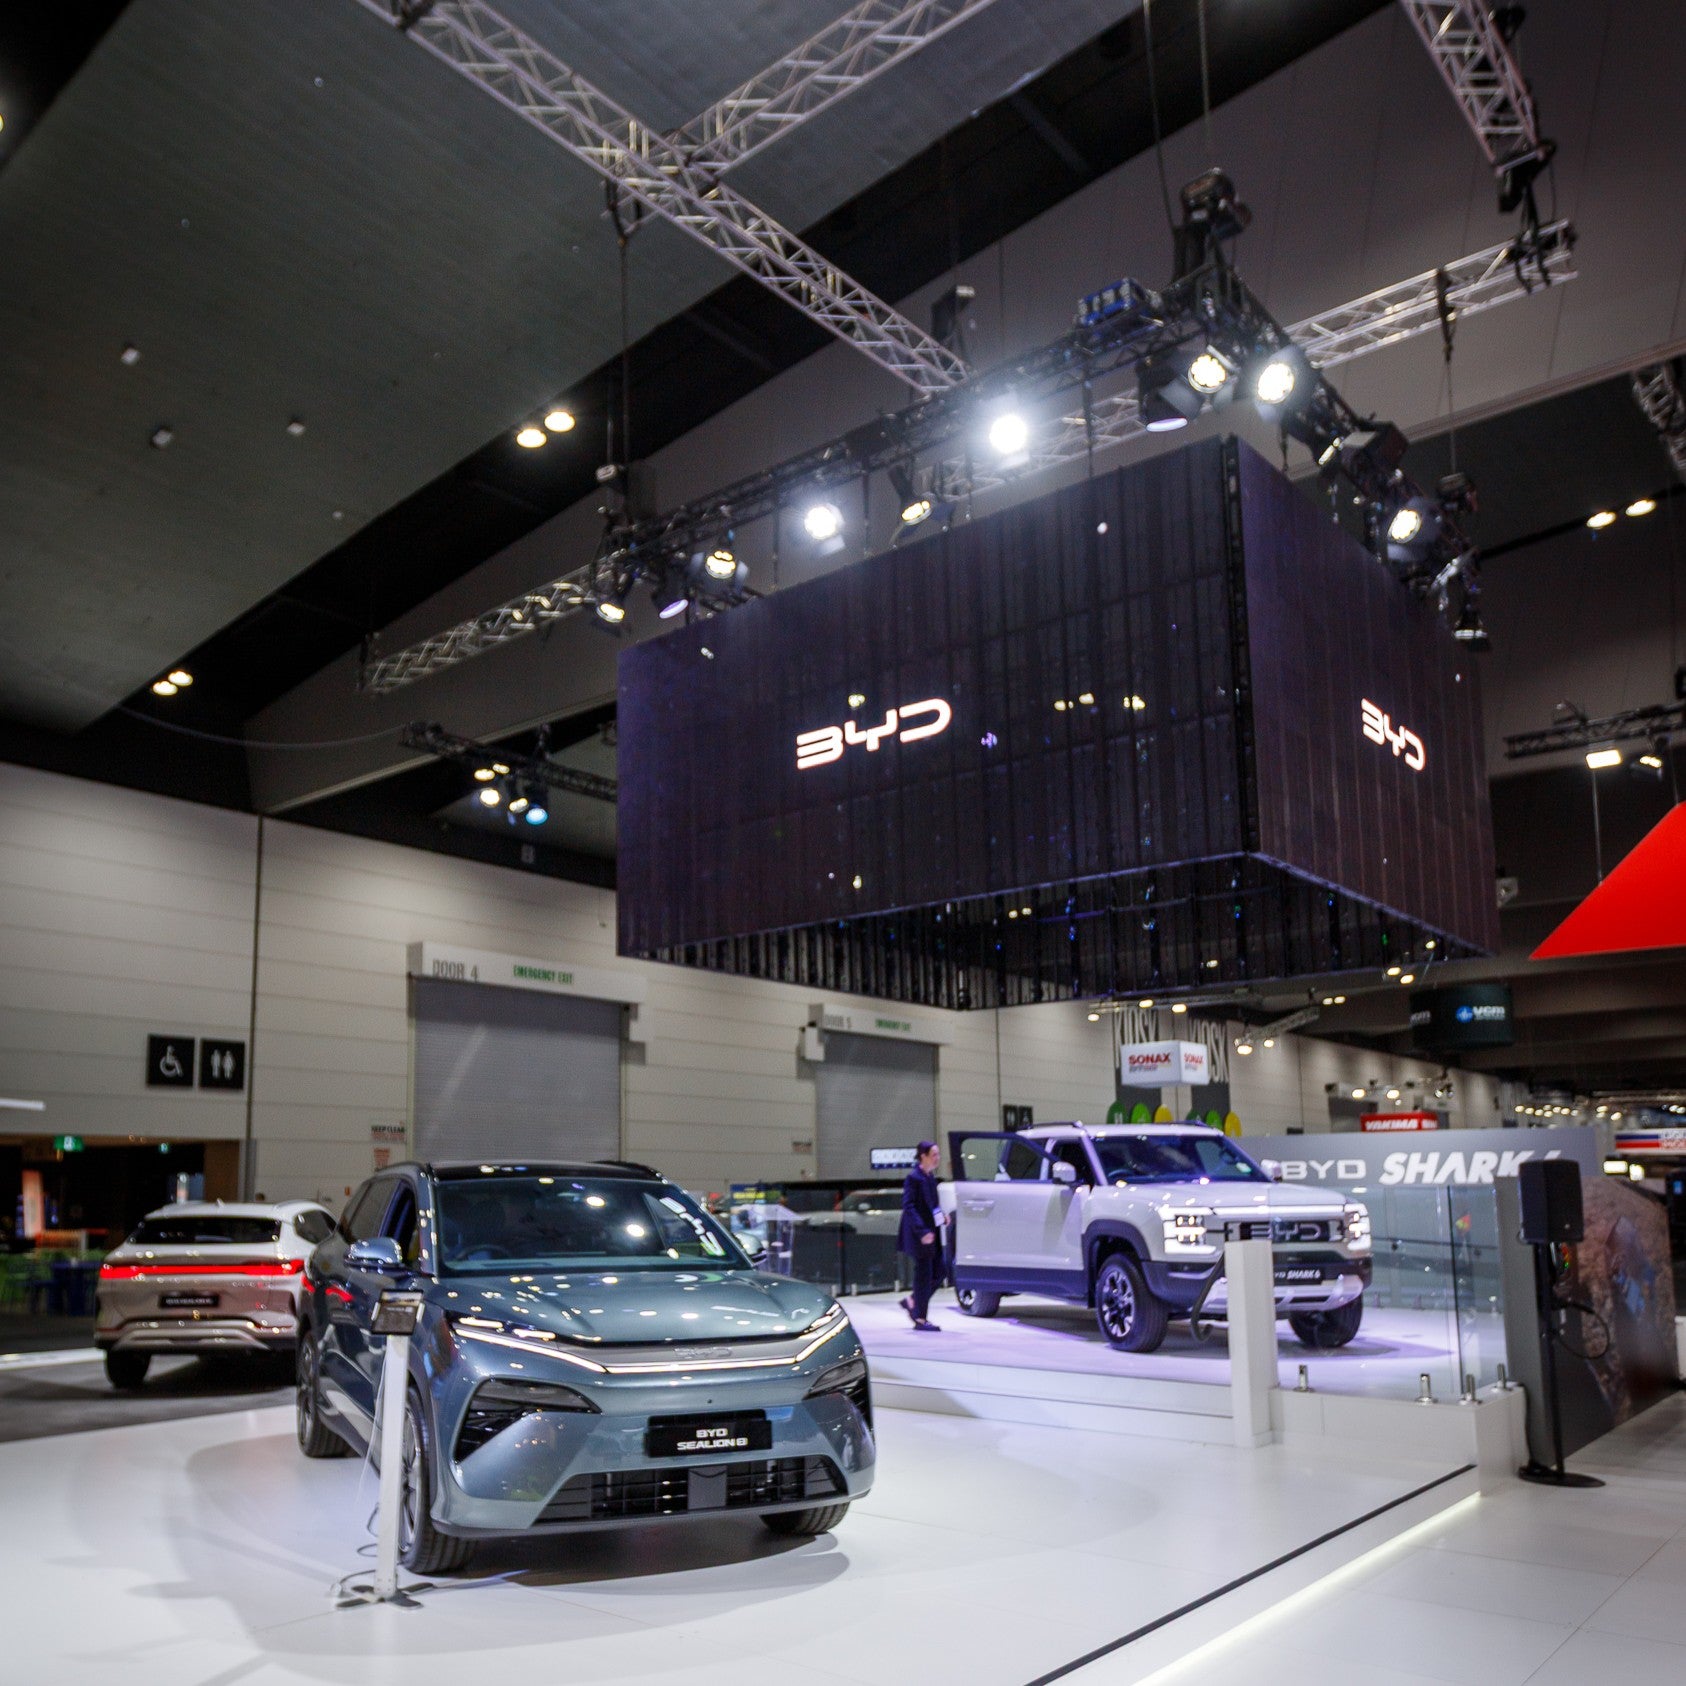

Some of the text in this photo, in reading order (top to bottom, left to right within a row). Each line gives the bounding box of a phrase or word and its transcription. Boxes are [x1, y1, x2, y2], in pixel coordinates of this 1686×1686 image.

[796, 698, 952, 770] BYD
[1360, 697, 1427, 772] BYD
[433, 959, 479, 982] DOOR 4
[557, 971, 573, 985] EXIT
[1128, 1053, 1171, 1066] SONAX
[1365, 1118, 1419, 1131] YAKIMA
[1281, 1150, 1535, 1185] BYD SHARK
[1250, 1223, 1321, 1241] BYD
[1287, 1269, 1314, 1280] SHARK
[696, 1427, 728, 1438] BYD
[677, 1440, 735, 1450] SEALION
